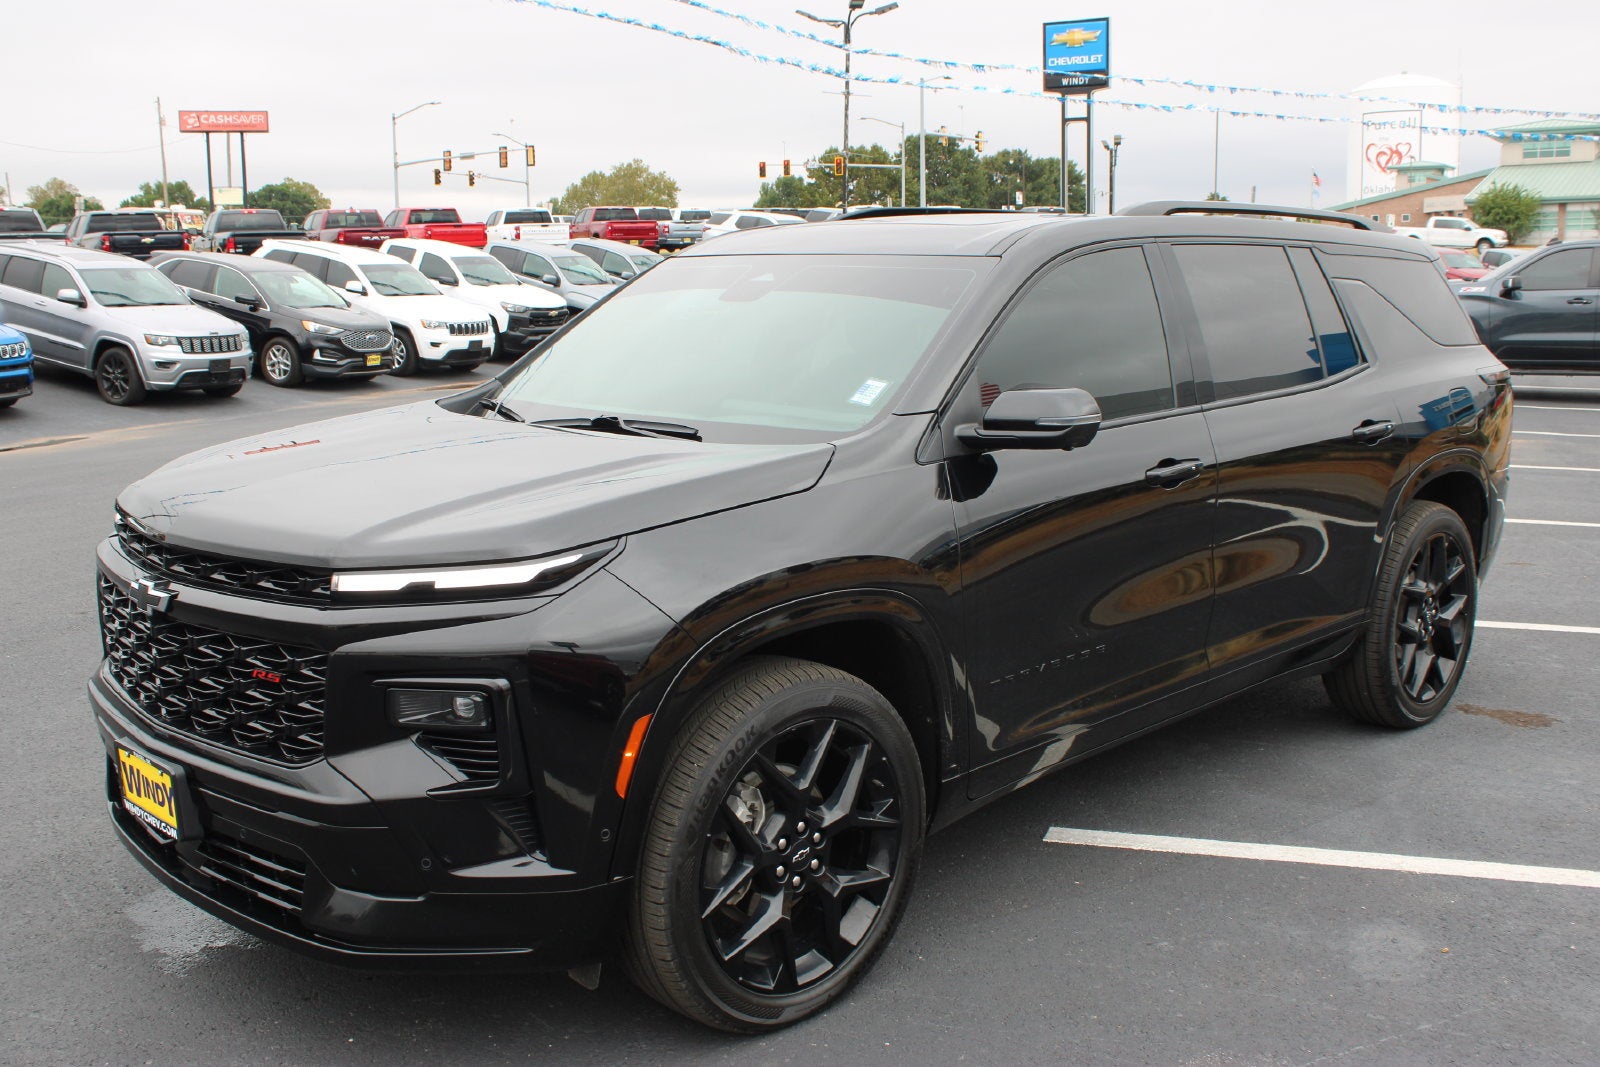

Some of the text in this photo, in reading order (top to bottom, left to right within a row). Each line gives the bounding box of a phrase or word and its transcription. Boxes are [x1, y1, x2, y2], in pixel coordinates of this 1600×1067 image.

[1048, 54, 1103, 67] CHEVROLET
[1061, 77, 1089, 86] WINDY
[200, 114, 265, 124] CASHSAVER
[252, 669, 281, 683] RS
[120, 760, 175, 818] WINDY
